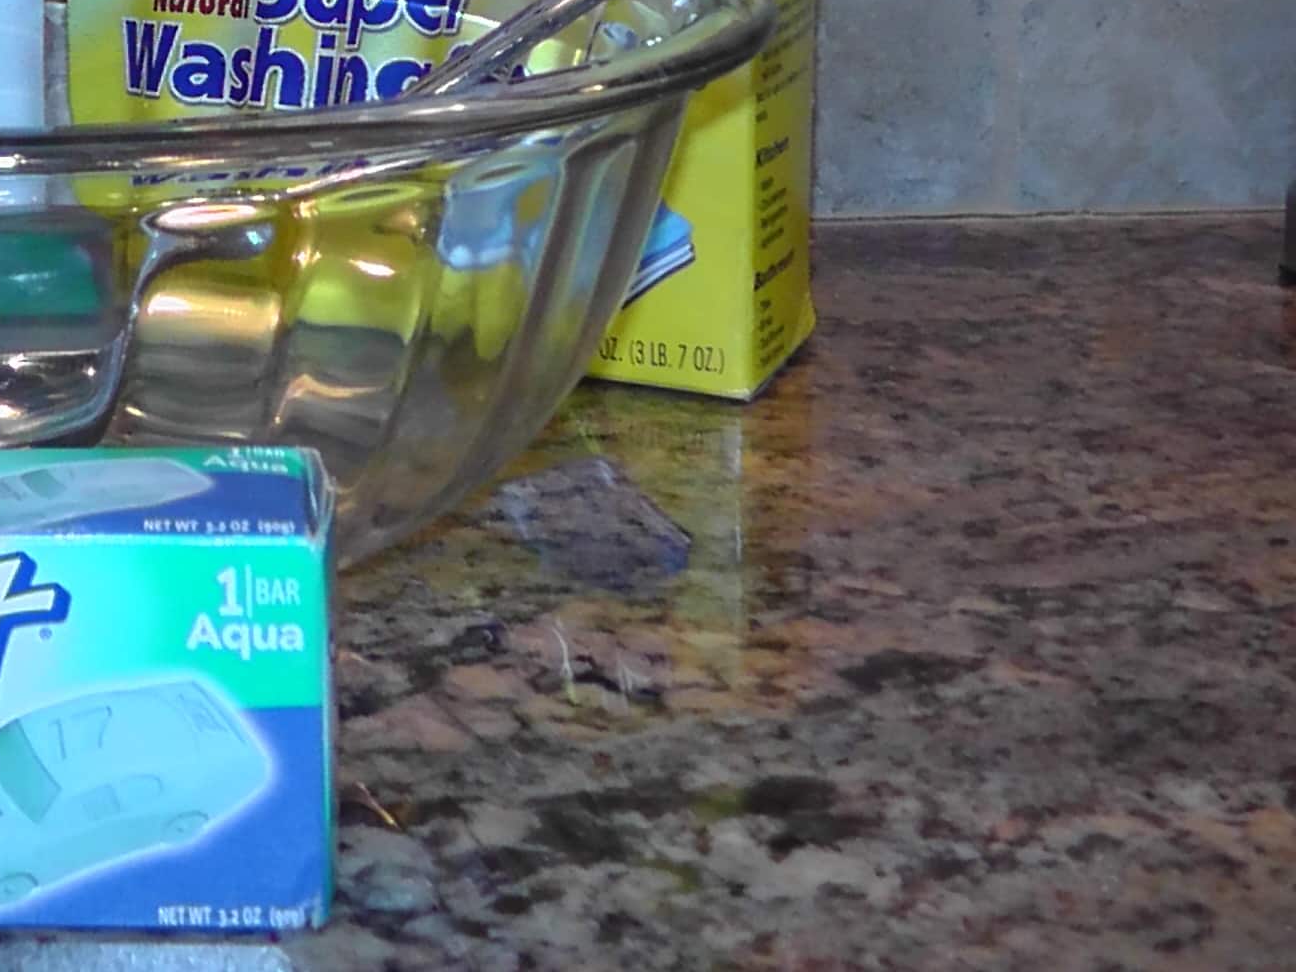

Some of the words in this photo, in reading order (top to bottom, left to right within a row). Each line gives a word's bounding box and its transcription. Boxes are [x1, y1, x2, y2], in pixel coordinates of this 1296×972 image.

[628, 339, 646, 366] (3
[649, 341, 673, 369] LB.
[676, 344, 688, 370] 7
[692, 345, 726, 376] OZ.)
[255, 577, 302, 605] BAR
[186, 611, 305, 661] Aqua
[157, 905, 185, 926] NET
[188, 905, 212, 926] WT
[242, 905, 263, 926] OZ
